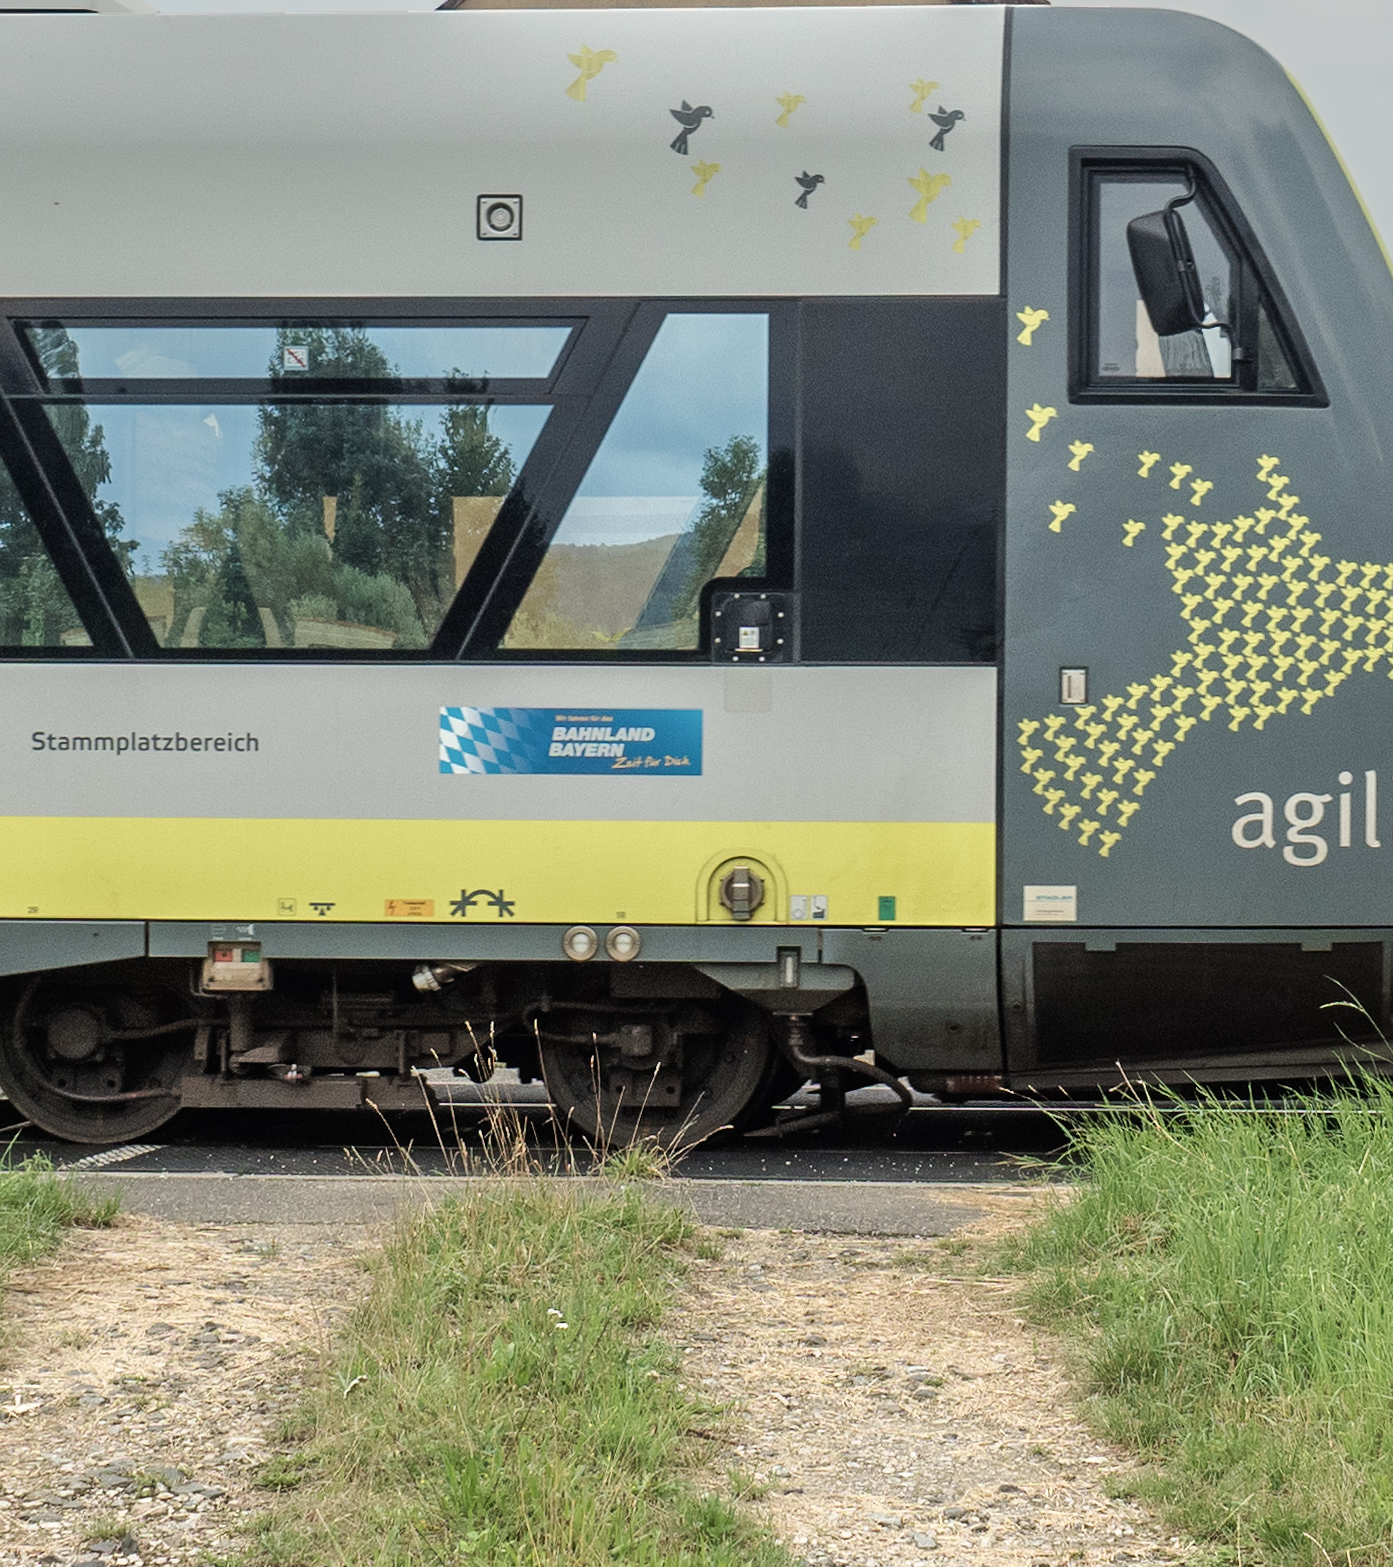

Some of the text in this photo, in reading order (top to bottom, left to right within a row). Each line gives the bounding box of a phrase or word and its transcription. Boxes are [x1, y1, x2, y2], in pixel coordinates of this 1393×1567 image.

[552, 726, 656, 742] BAHNLAND
[31, 732, 260, 756] Stammplatzbereich
[548, 742, 626, 758] BAYERN
[611, 755, 642, 769] Zeit
